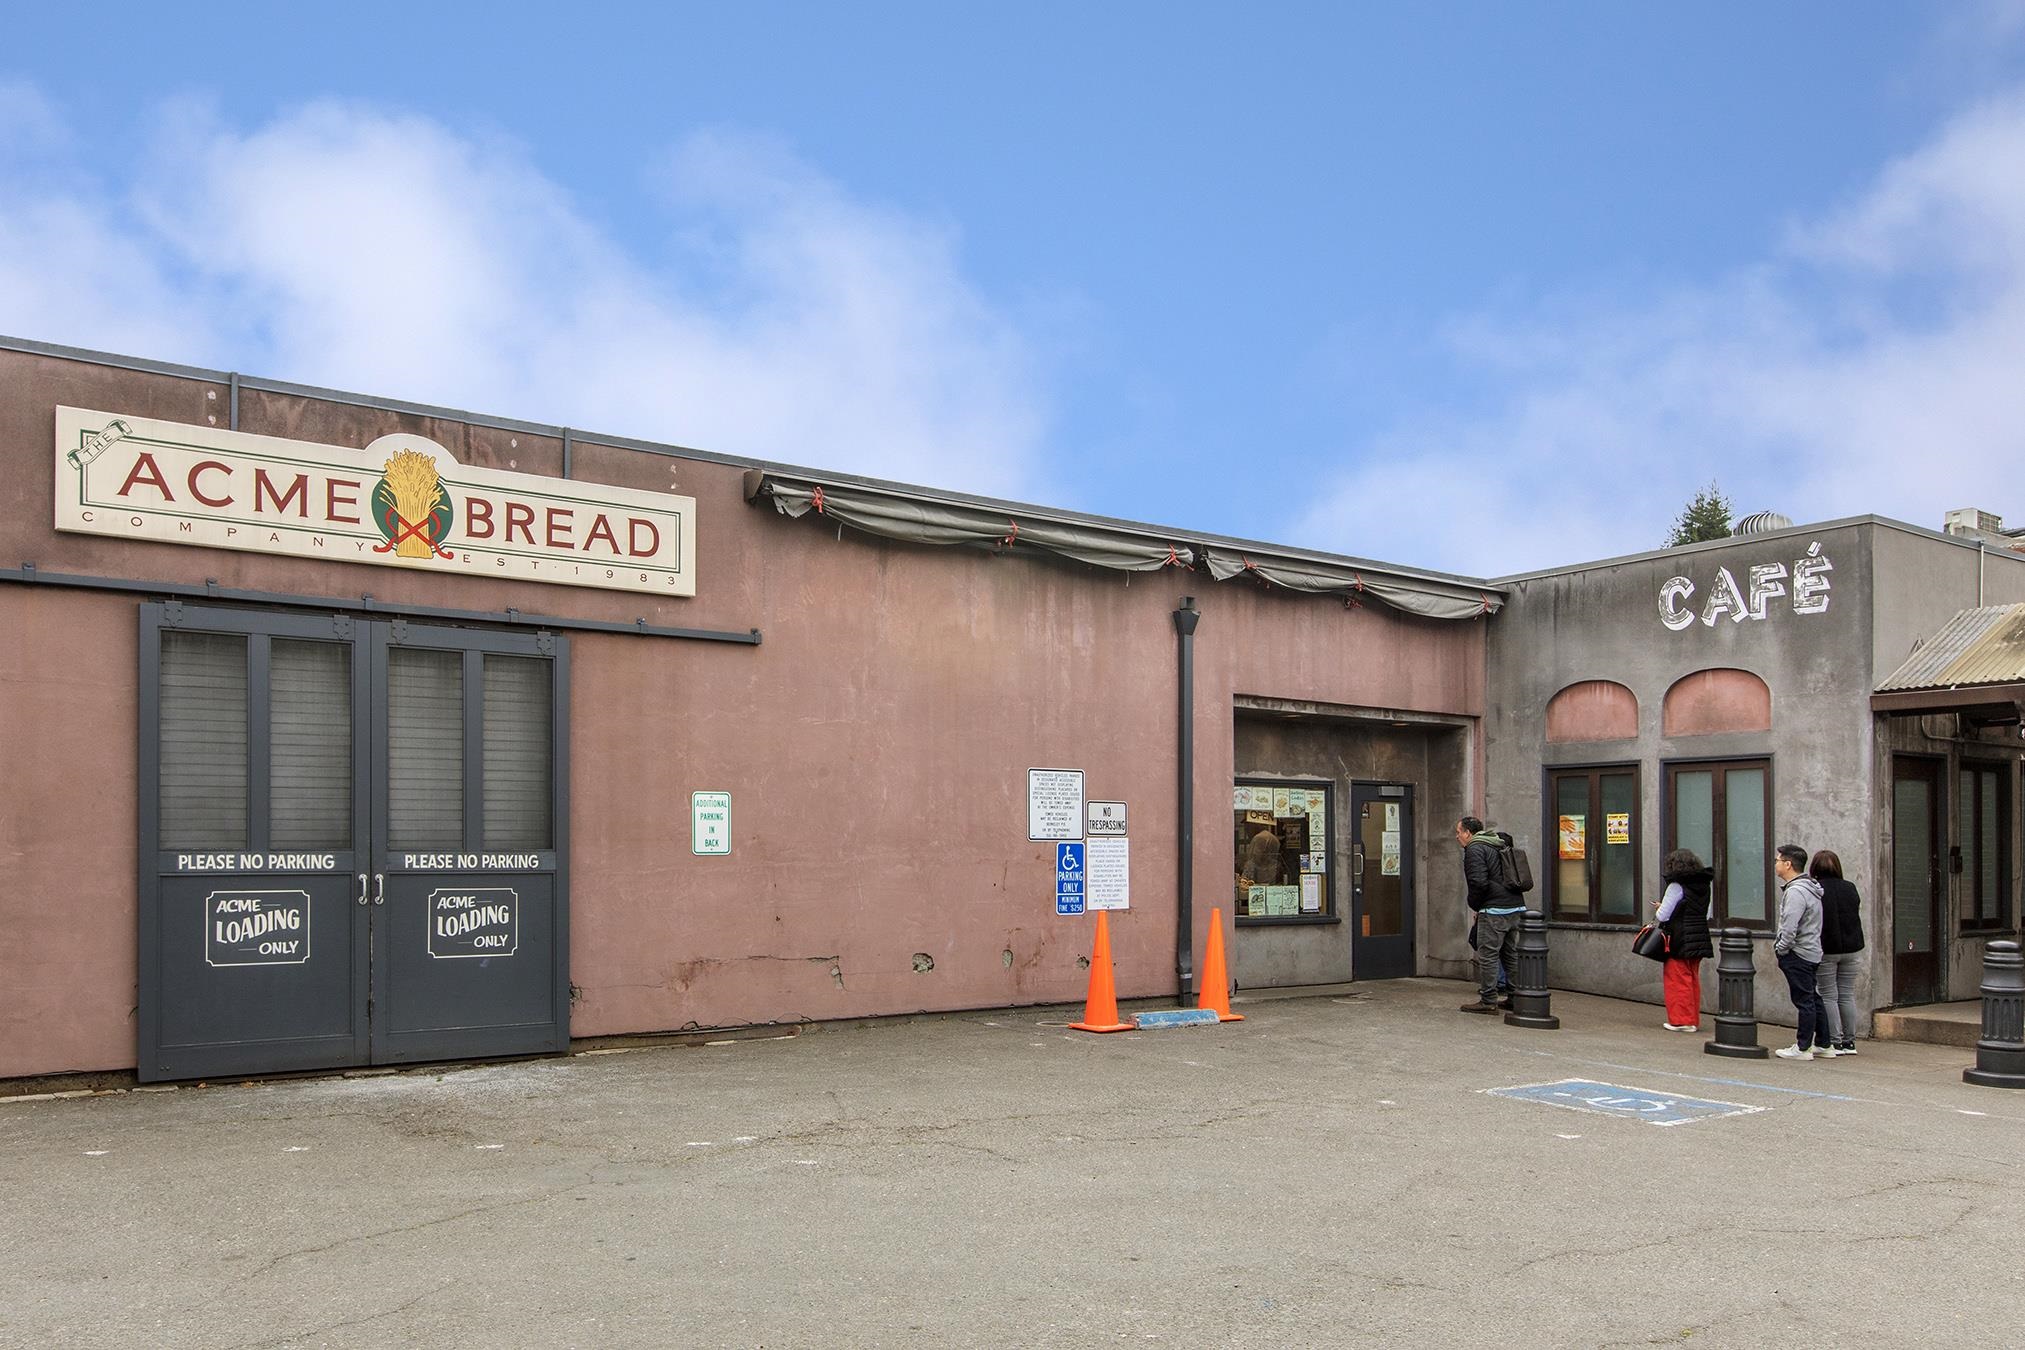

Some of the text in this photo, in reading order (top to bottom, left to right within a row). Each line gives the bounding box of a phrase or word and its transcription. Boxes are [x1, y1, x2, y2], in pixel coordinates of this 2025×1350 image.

[86, 433, 112, 458] THE
[117, 452, 661, 558] ACME BREAD
[82, 511, 365, 551] COMPANY
[1658, 541, 1833, 631] CAFÉ
[696, 800, 727, 808] ADDITIONAL
[700, 813, 723, 821] PARKING
[1103, 807, 1112, 817] NO
[1250, 810, 1274, 821] OPEN
[1089, 820, 1125, 830] TRESPASSING
[705, 839, 719, 847] BACK
[178, 854, 335, 870] PLEASE NO PARKING
[404, 854, 539, 869] PLEASE NO PARKING
[1058, 871, 1083, 881] PARKING
[1063, 882, 1079, 893] ONLY
[216, 899, 262, 913] ACME
[437, 896, 476, 909] ACME
[216, 908, 300, 944] LOADING
[437, 905, 510, 937] LOADING
[259, 940, 299, 955] ONLY
[473, 934, 508, 948] ONLY
